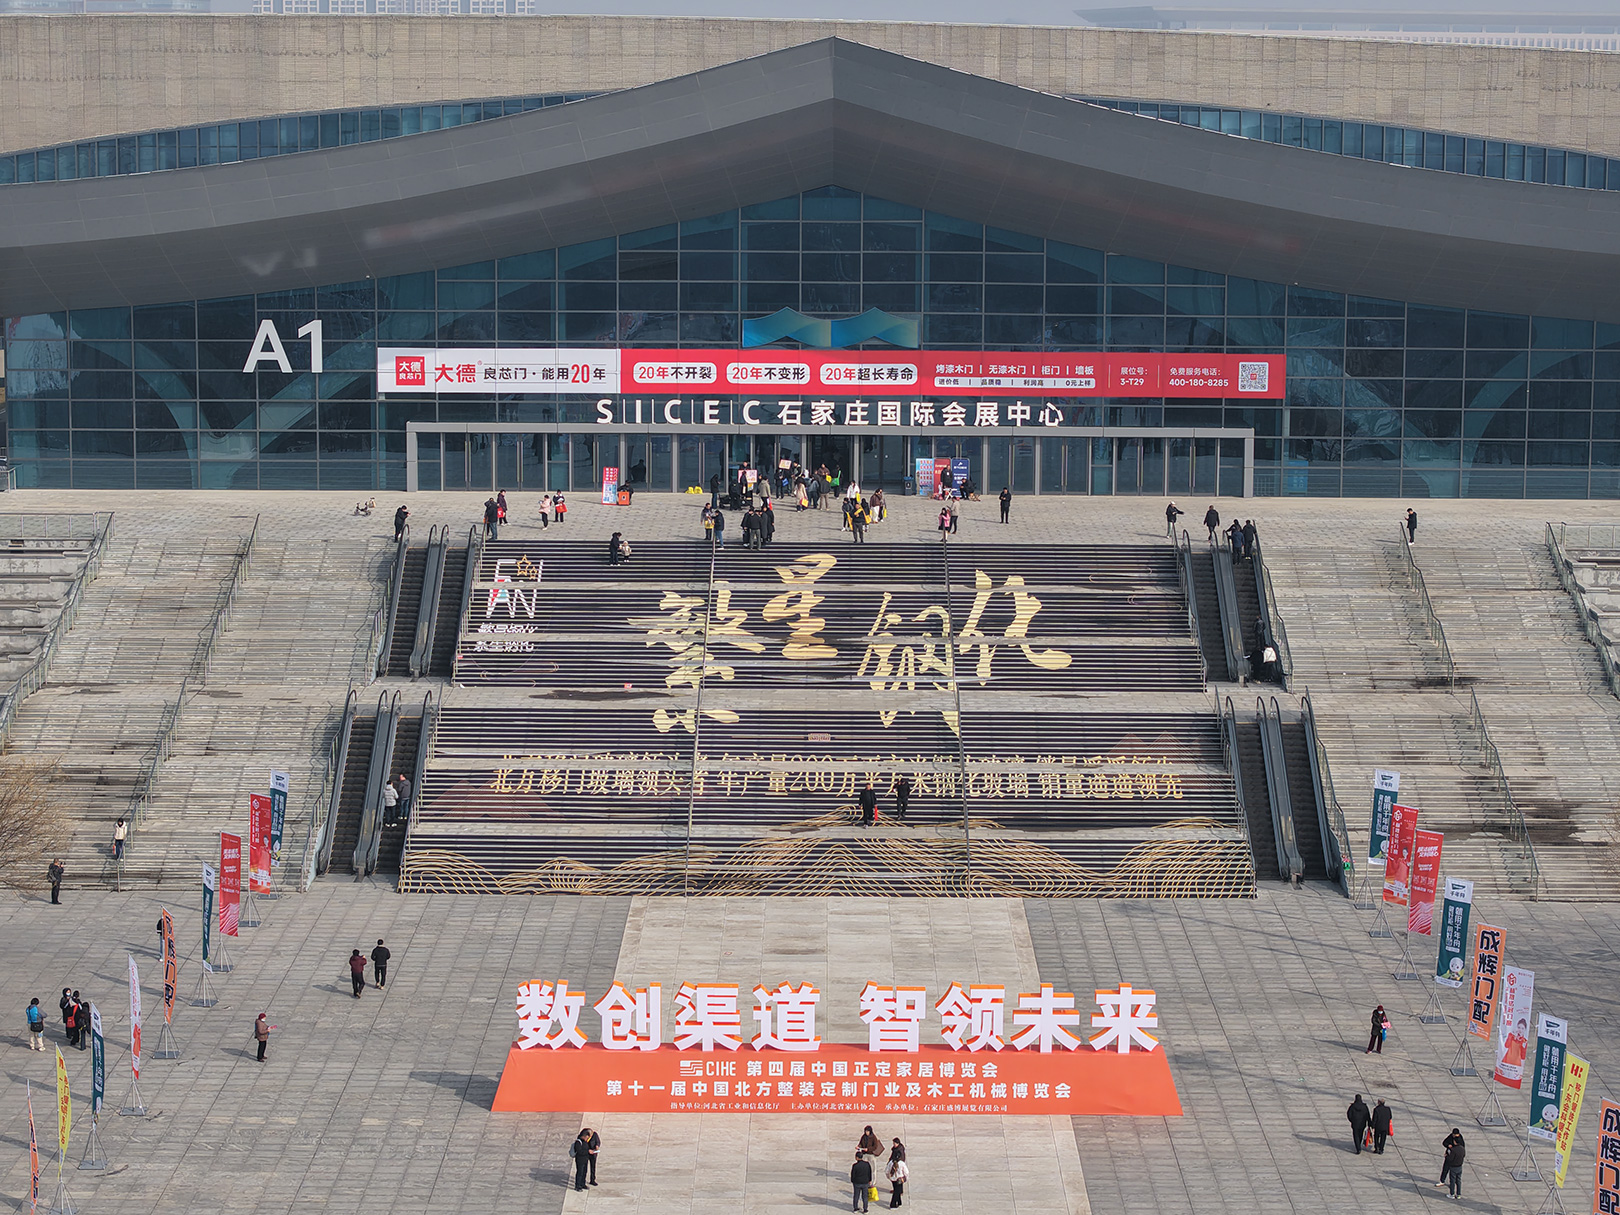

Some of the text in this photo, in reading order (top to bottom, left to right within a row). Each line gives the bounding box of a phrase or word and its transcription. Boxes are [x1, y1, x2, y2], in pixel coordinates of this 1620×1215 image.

[242, 319, 323, 373] A1
[434, 363, 476, 383] 大德
[638, 366, 713, 380] 20年不开裂
[732, 366, 806, 381] 20年不变形
[825, 367, 914, 382] 20年超长寿命
[935, 364, 974, 374] 烤漆木门
[988, 365, 1027, 375] 无漆木门
[1119, 378, 1145, 386] 3-T29
[1168, 379, 1230, 387] 400-180-8285
[777, 399, 1065, 427] 石家庄国际会展中心
[1471, 929, 1501, 1025] 成辉门配
[515, 978, 821, 1052] 数创渠道
[859, 980, 1160, 1054] 智领未来
[706, 1060, 999, 1079] CIHE 第四届中国正定家居博览会
[606, 1079, 1073, 1099] 第十一届中国北方整装定制门业及木工机械博览会
